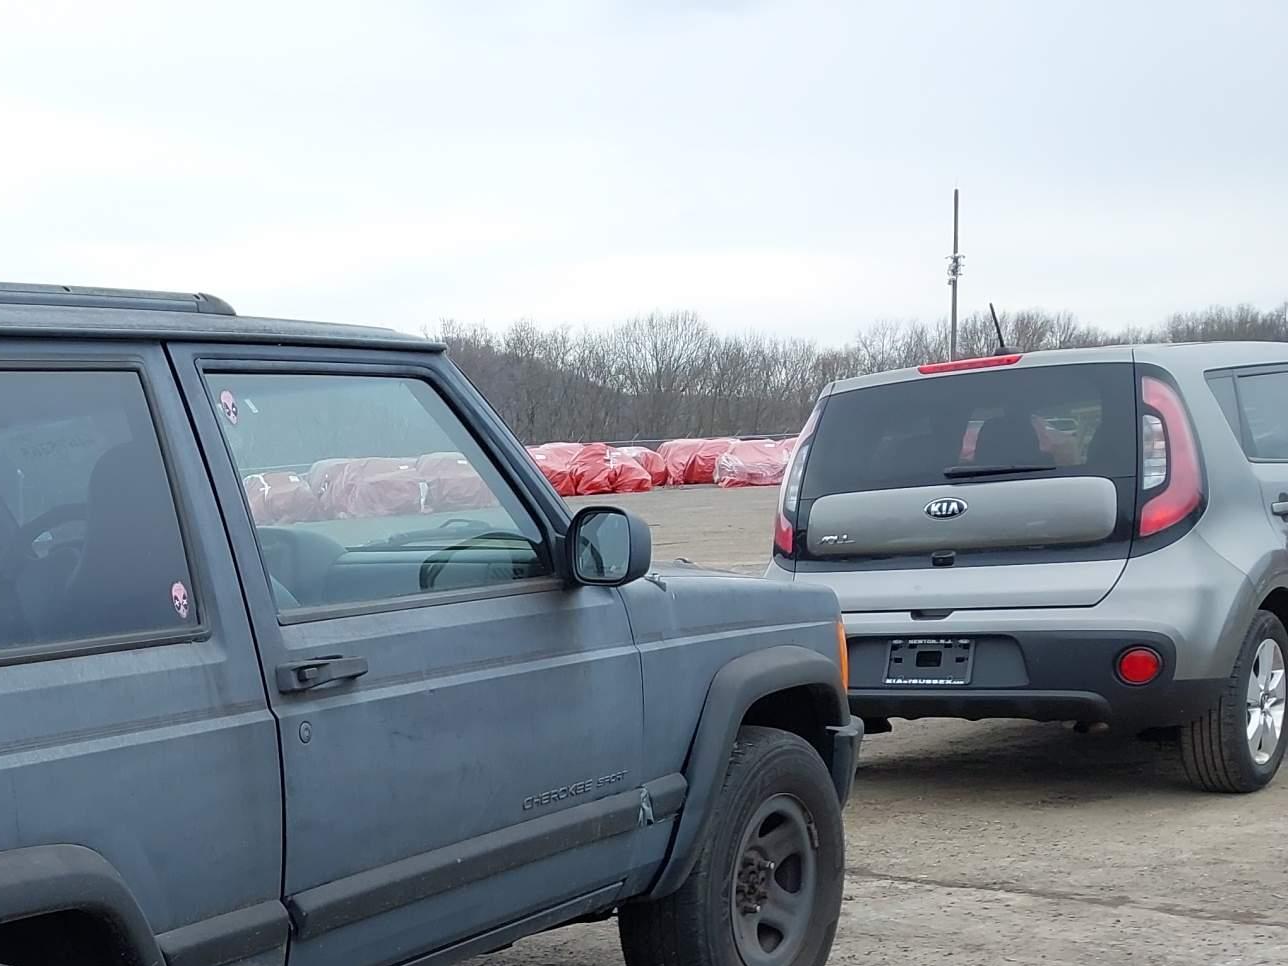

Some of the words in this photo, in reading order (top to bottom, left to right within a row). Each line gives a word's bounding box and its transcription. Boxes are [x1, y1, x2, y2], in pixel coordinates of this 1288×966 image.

[930, 501, 960, 516] KIA
[522, 778, 593, 811] CHEROKEE
[595, 768, 630, 789] SPORT
